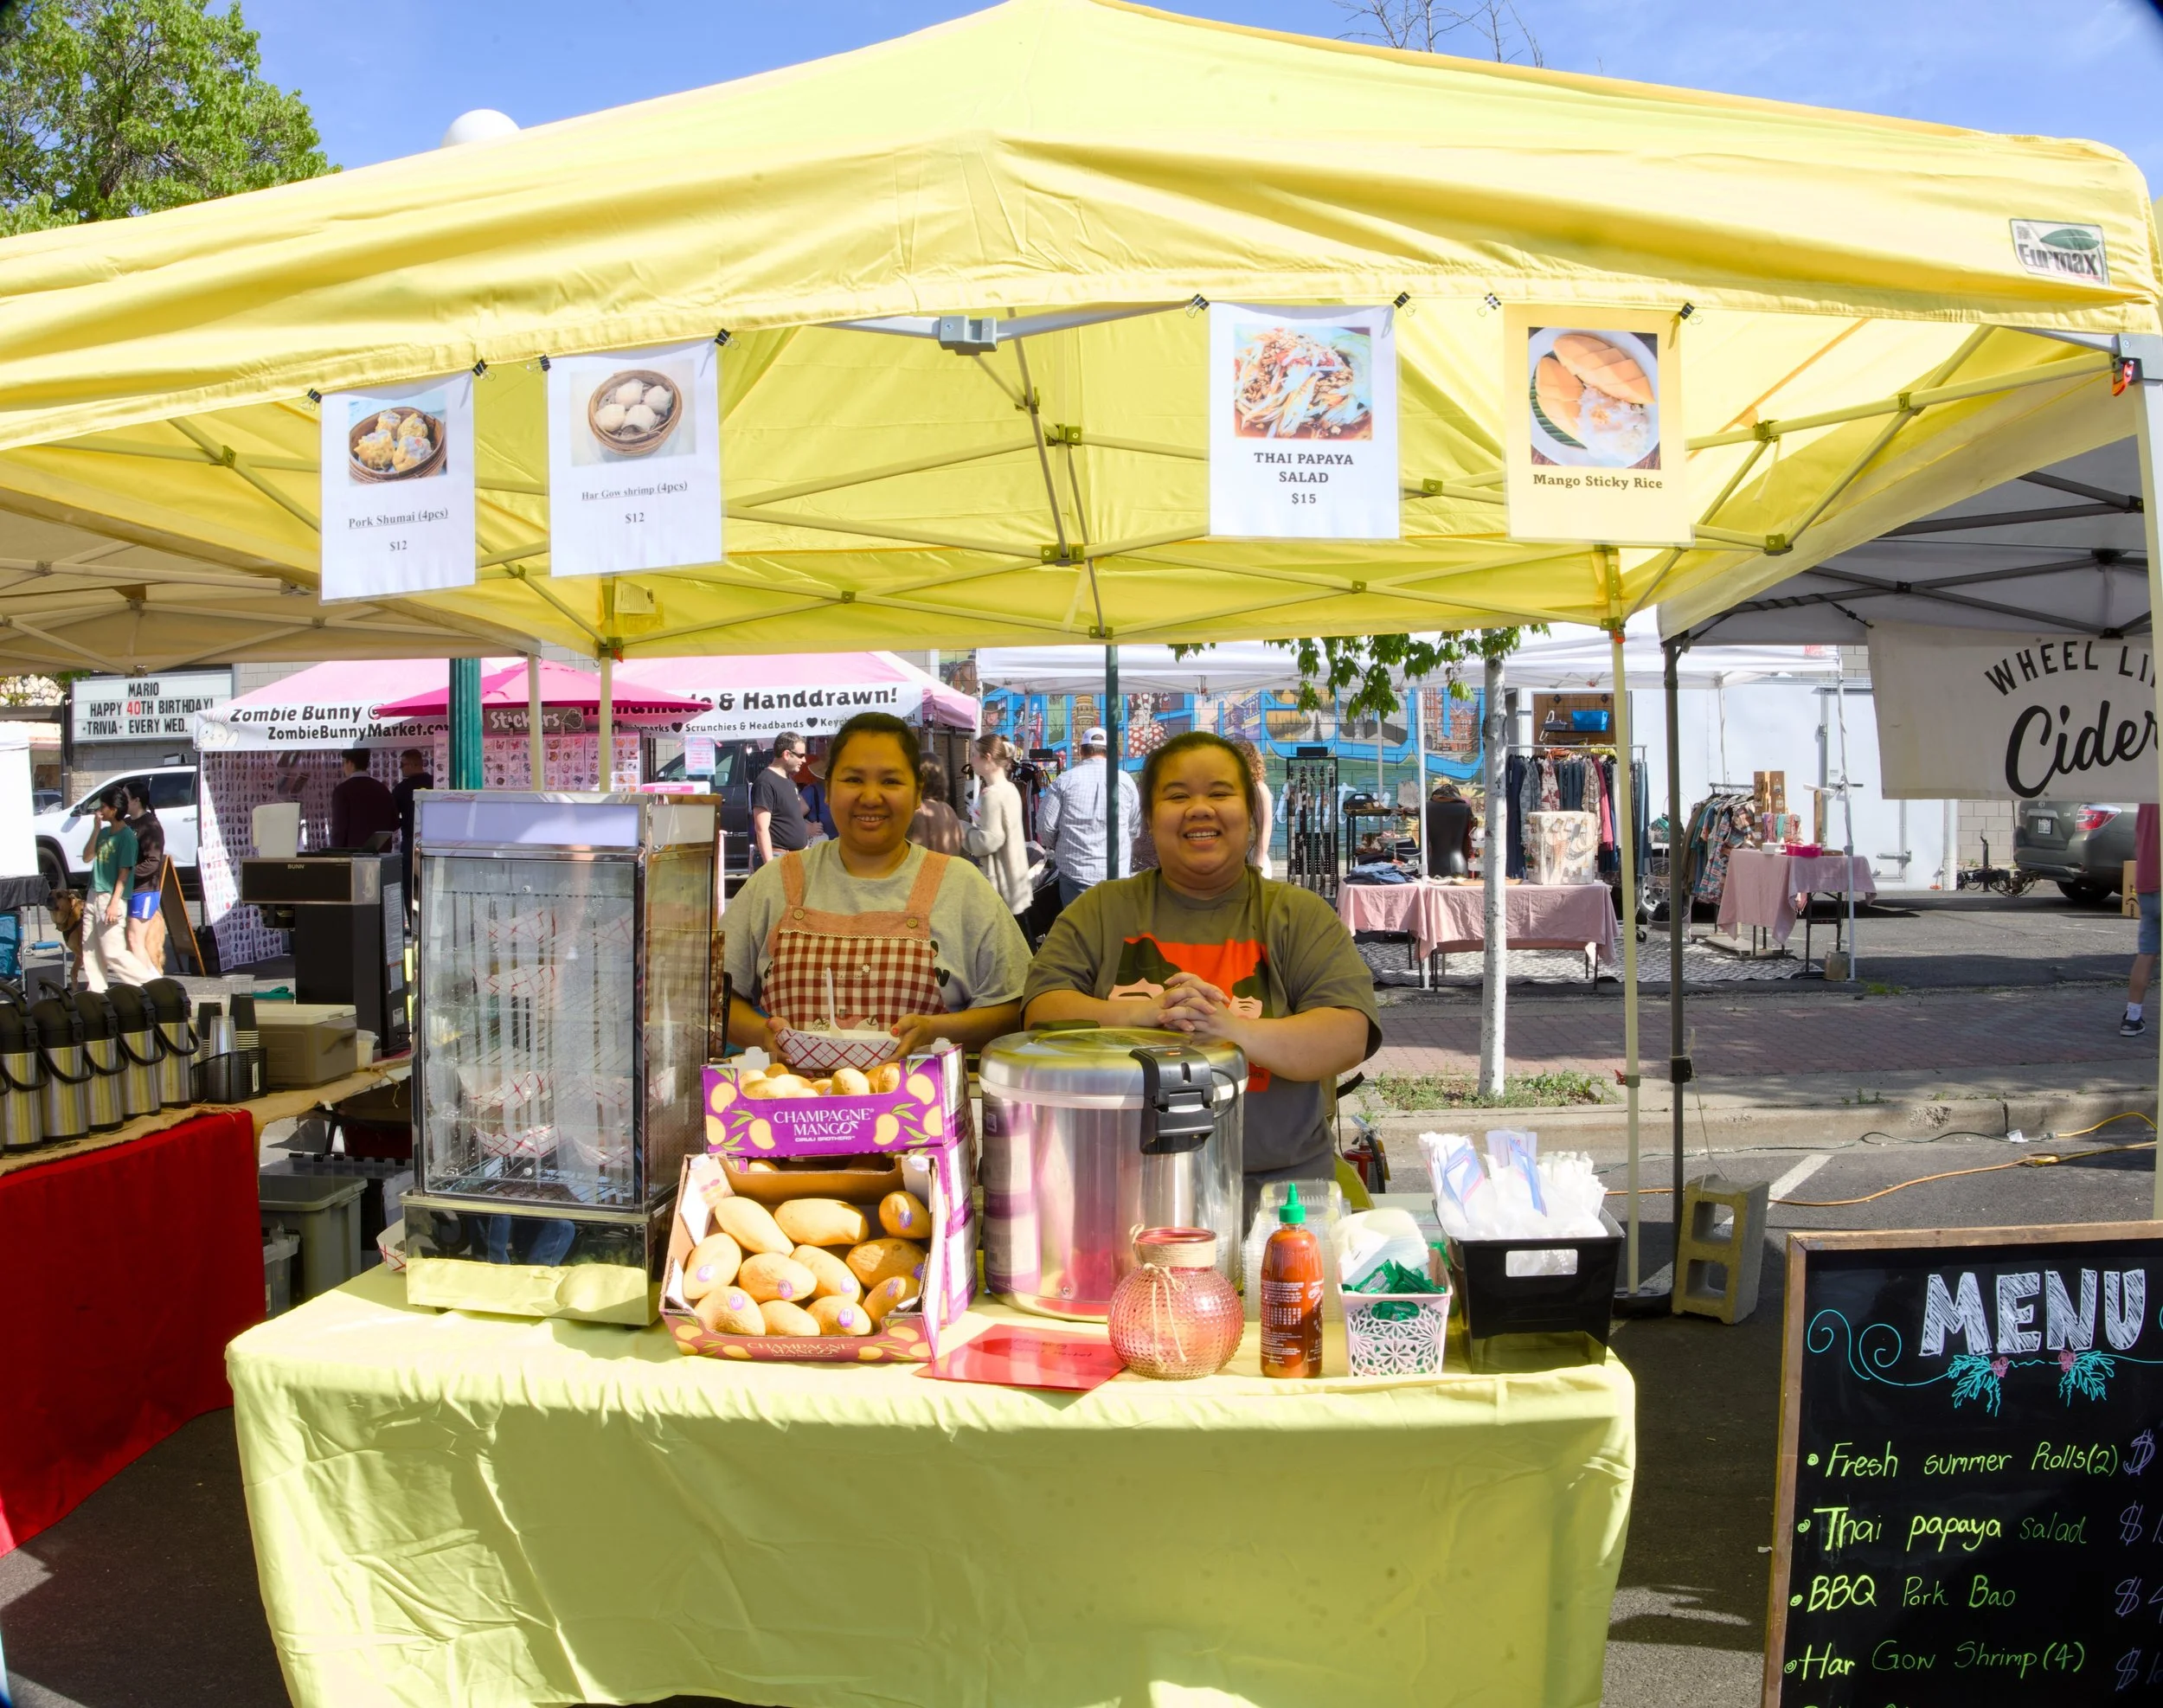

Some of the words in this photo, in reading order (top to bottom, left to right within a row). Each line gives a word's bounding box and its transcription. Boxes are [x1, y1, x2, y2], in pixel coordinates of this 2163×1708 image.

[1254, 453, 1292, 464] THAI
[1298, 453, 1354, 465] PAPAYA
[1279, 471, 1329, 483] SALAD
[1533, 474, 1581, 488] Mango
[1585, 476, 1628, 490] Sticky
[1633, 478, 1663, 488] Rice
[582, 491, 599, 500] Har
[601, 489, 620, 498] Gow
[624, 486, 655, 496] shrimp
[657, 481, 688, 494] (4pcs)
[1292, 492, 1317, 504] $15
[349, 517, 373, 529] Pork
[376, 511, 415, 525] Shumai
[418, 507, 448, 522] (4pcs)
[625, 512, 645, 523] $12
[389, 540, 408, 551] $12
[1984, 640, 2099, 696] WHEEL
[2118, 645, 2156, 688] LI
[128, 682, 160, 697] MARIO
[719, 693, 735, 710] &
[743, 687, 897, 710] Handdrawn!
[90, 703, 123, 717] HAPPY
[126, 700, 154, 716] 40TH
[158, 698, 214, 715] BIRTHDAY!
[230, 705, 297, 722] Zombie
[302, 705, 362, 722] Bunny
[129, 719, 160, 734] EVERY
[164, 717, 189, 733] WED.
[490, 711, 561, 729] Stickrs
[685, 722, 737, 732] Scrunchies
[740, 722, 746, 730] &
[749, 719, 804, 730] Headbands
[2005, 700, 2158, 798] Cider
[793, 1122, 858, 1136] MANGO
[1919, 1268, 2146, 1357] MENU
[1826, 1441, 1899, 1478] Fresh
[1923, 1452, 2013, 1475] summer
[1813, 1507, 1883, 1551] Thai
[1907, 1516, 2003, 1552] papaya
[1807, 1575, 1877, 1613] BBQ
[1903, 1576, 1949, 1608] Pork
[1968, 1574, 2017, 1608] Bao
[1799, 1642, 1855, 1681] Har
[1954, 1641, 2038, 1680] Shrimp
[2043, 1643, 2087, 1680] (4)
